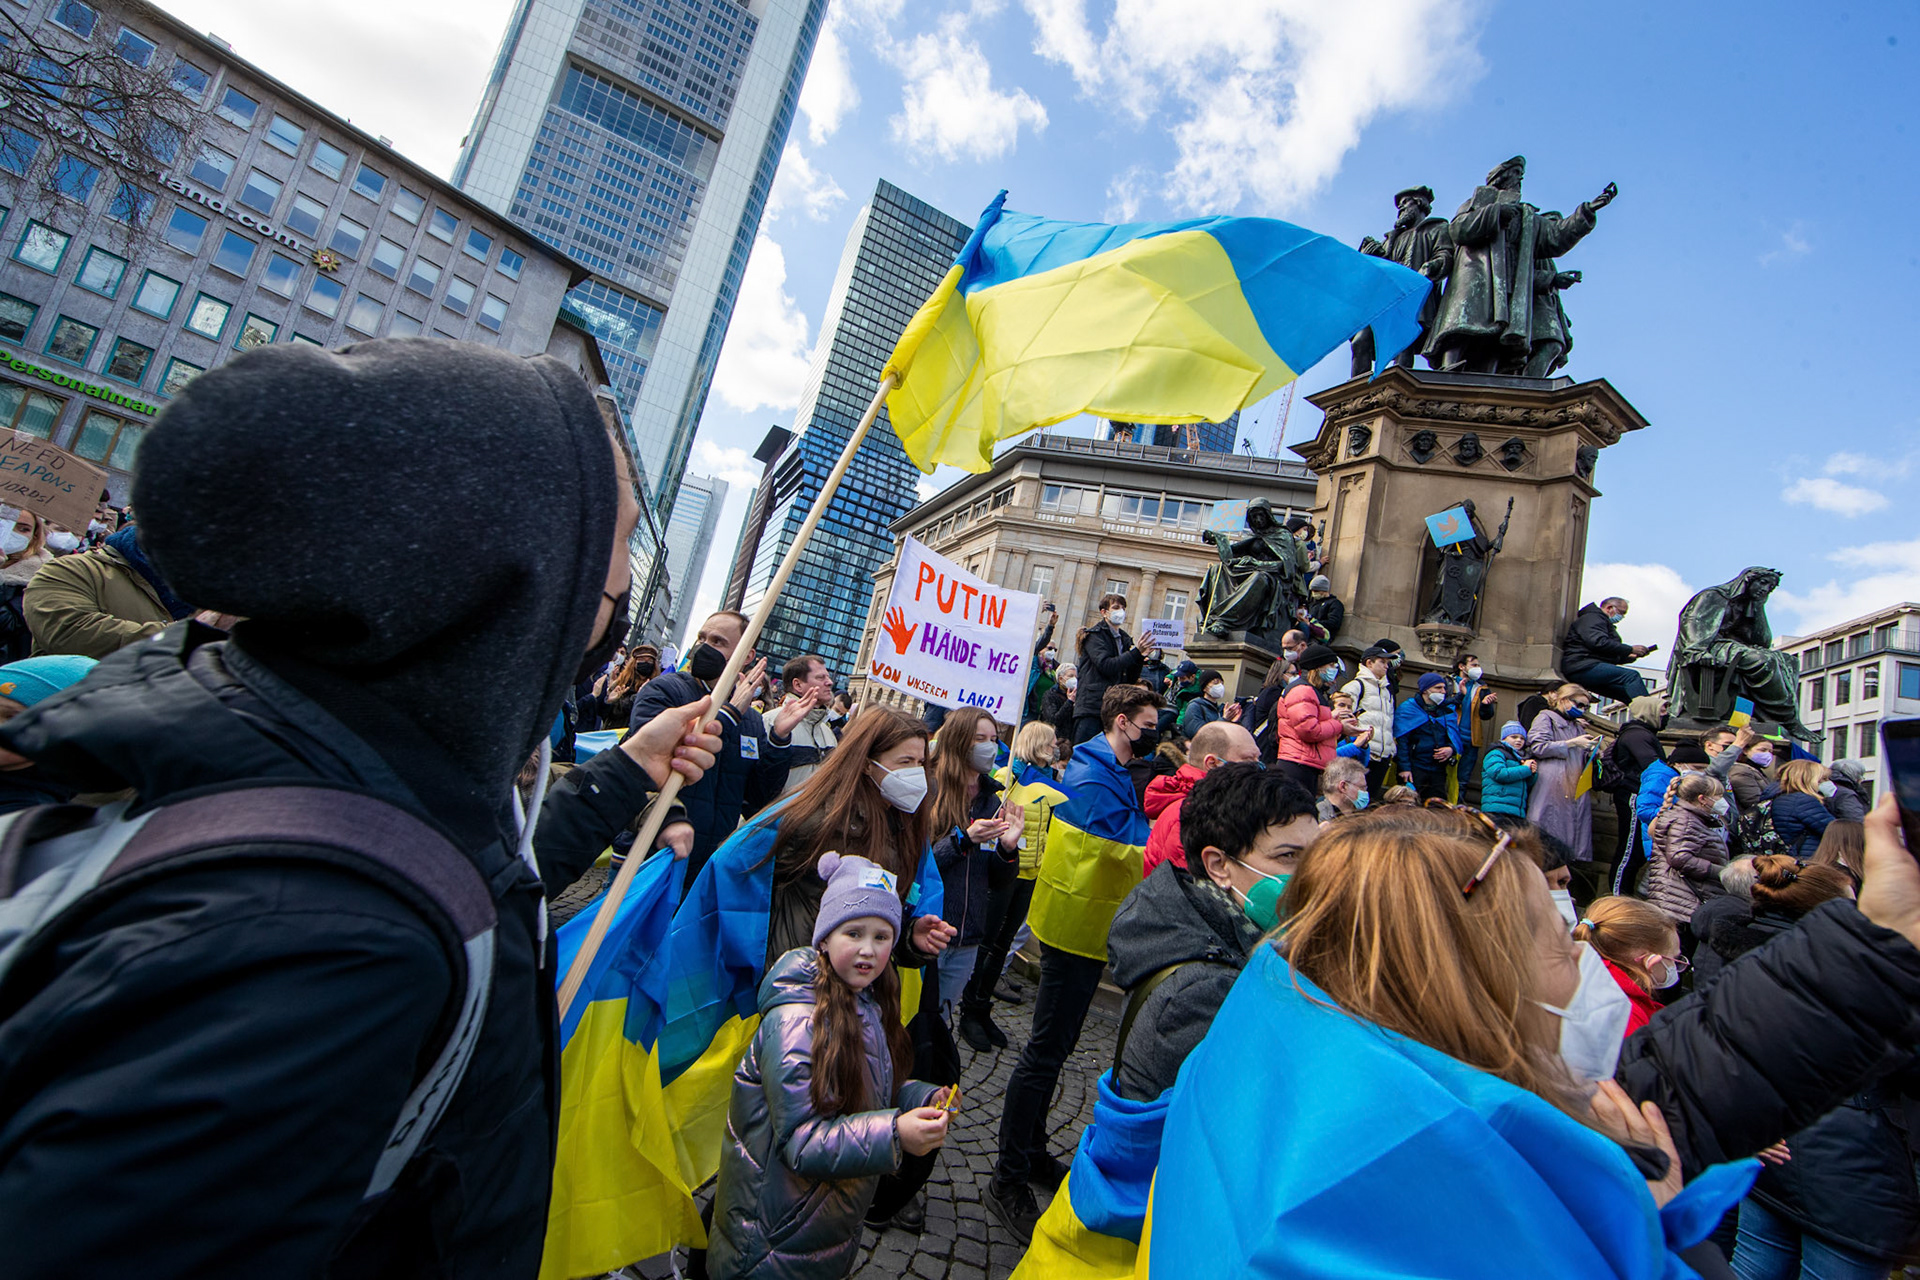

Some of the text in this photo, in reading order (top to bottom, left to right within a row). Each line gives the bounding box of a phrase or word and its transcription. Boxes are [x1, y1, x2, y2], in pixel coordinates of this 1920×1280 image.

[0, 436, 66, 470] NEED
[0, 453, 76, 493] EAPONS
[914, 561, 1008, 629] PUTIN
[919, 622, 1020, 675] HÄNDE WEG
[871, 660, 1004, 715] VON UNSEREM LAND!
